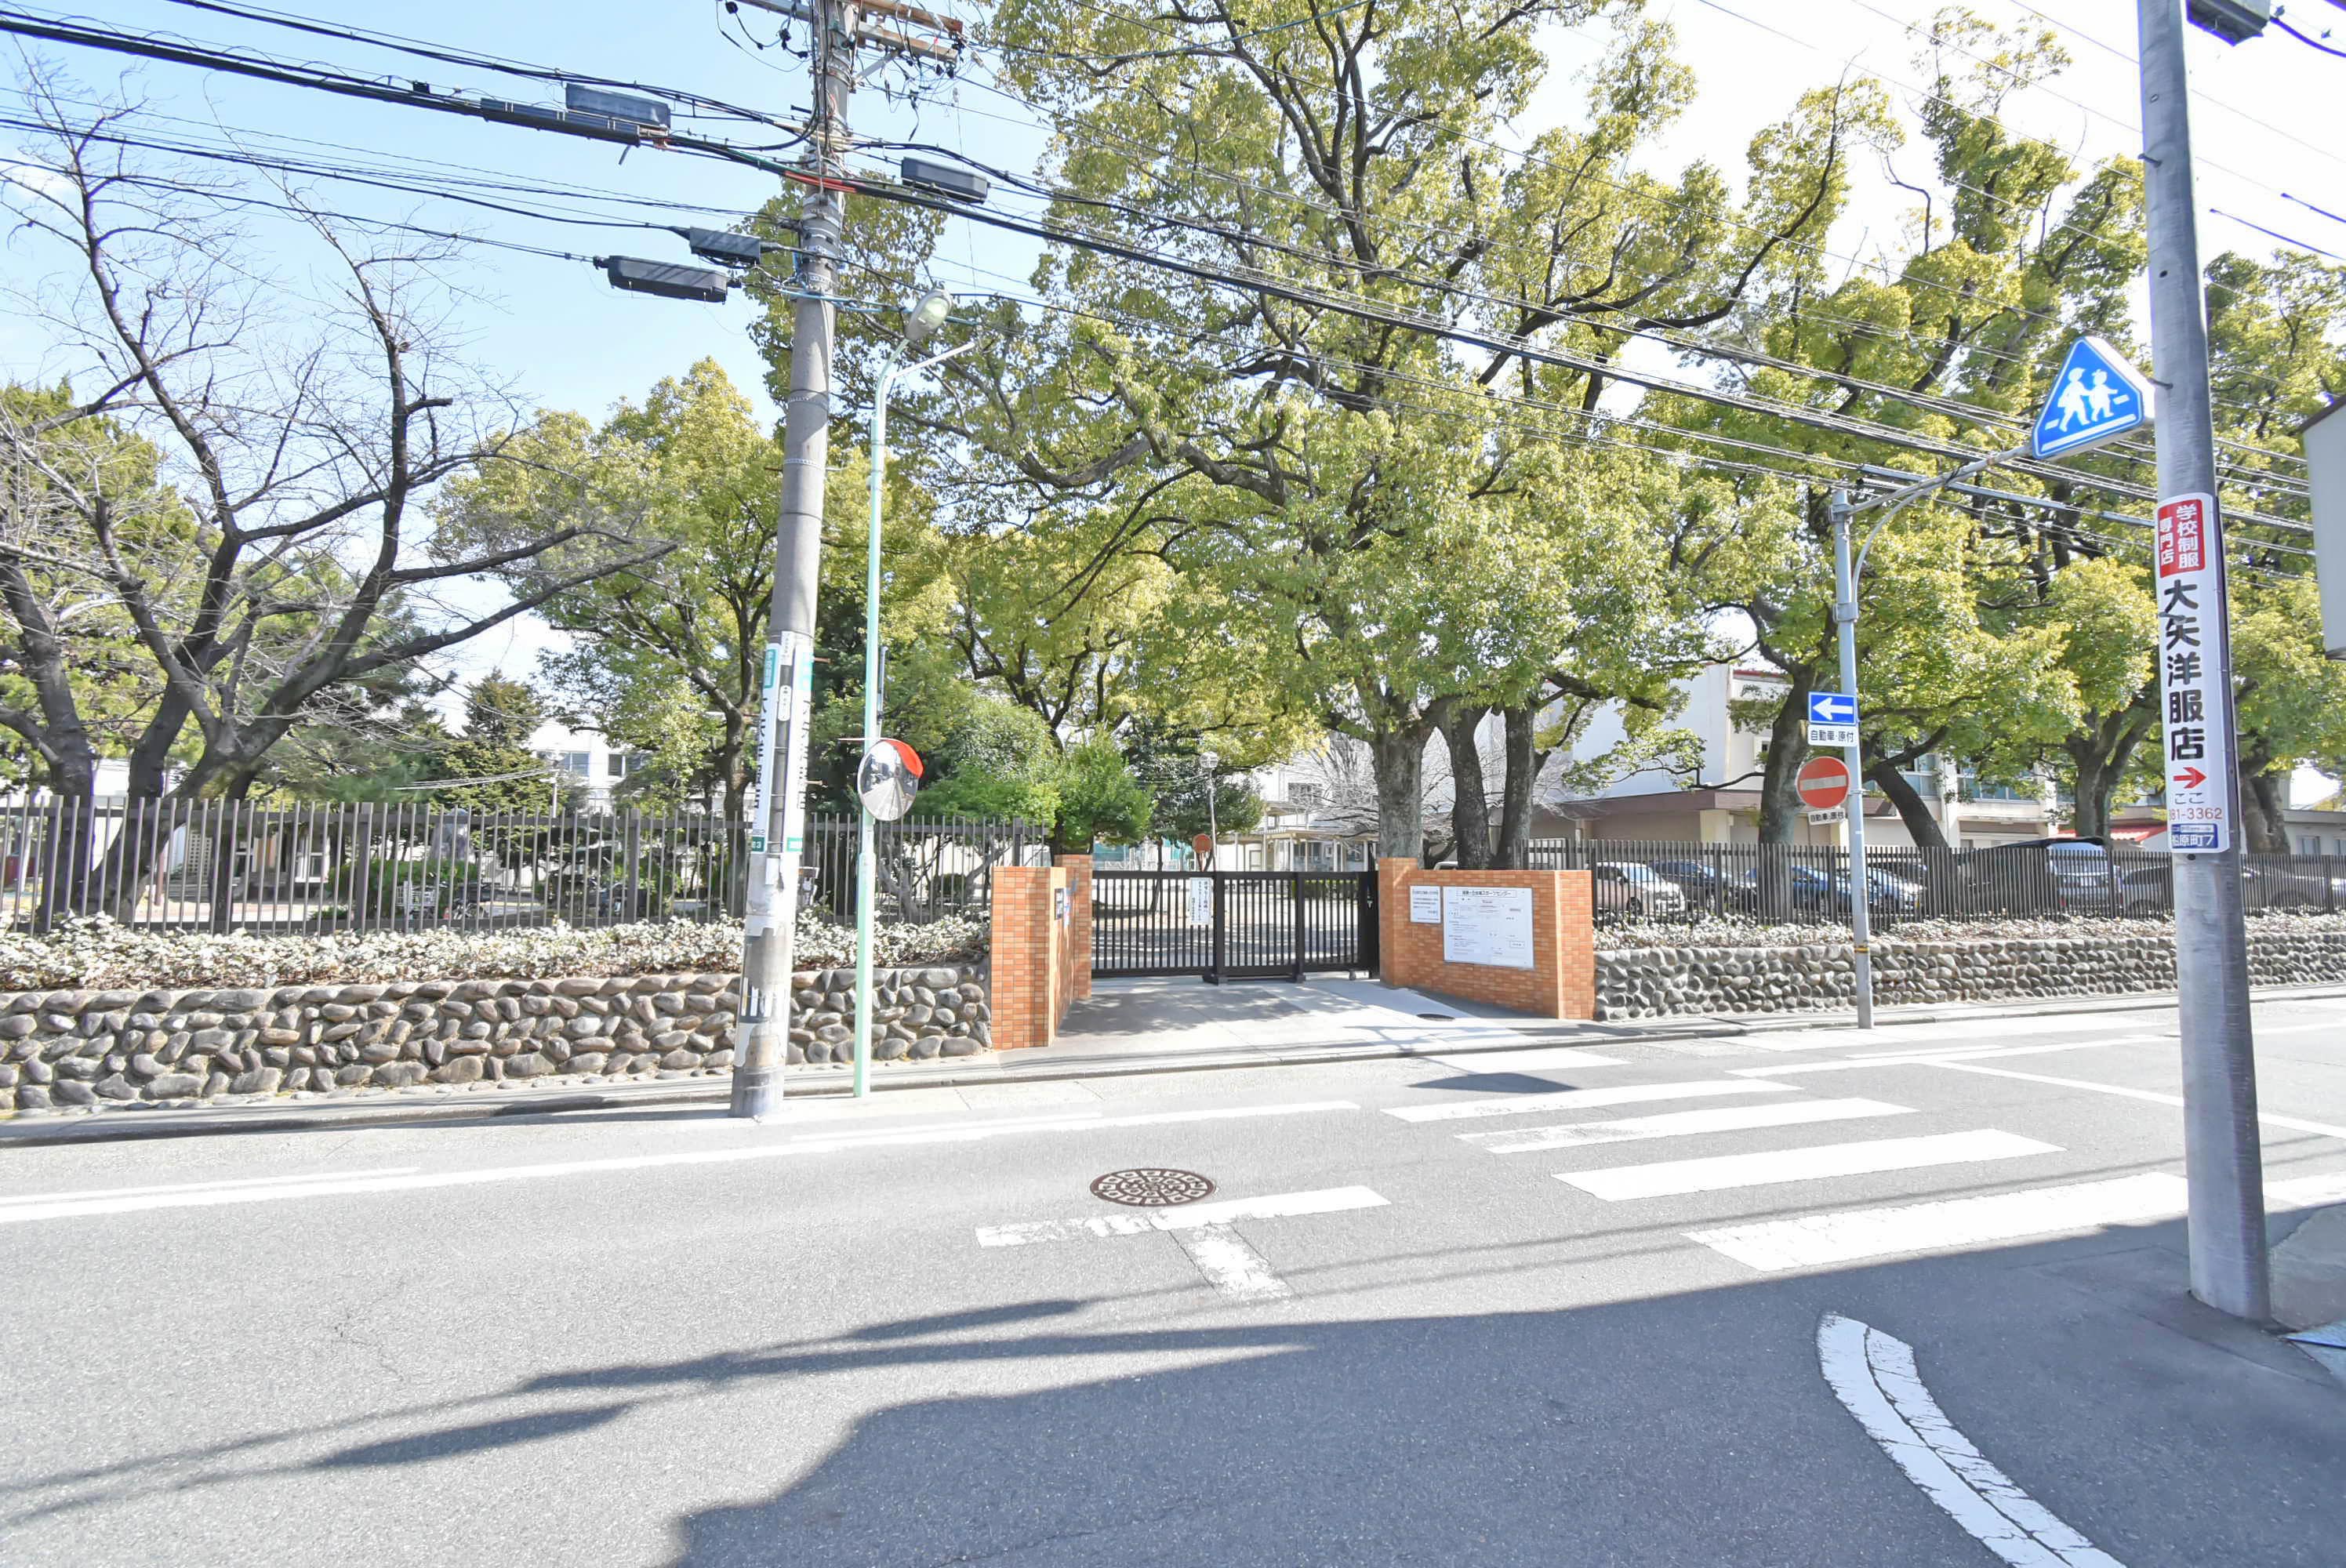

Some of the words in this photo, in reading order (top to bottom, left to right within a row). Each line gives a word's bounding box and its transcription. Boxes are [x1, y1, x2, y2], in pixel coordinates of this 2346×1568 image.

[2159, 516, 2174, 565] 専門店
[2176, 503, 2199, 568] 学校制服
[2163, 579, 2205, 761] 大矢洋服店
[2174, 792, 2204, 804] ここ
